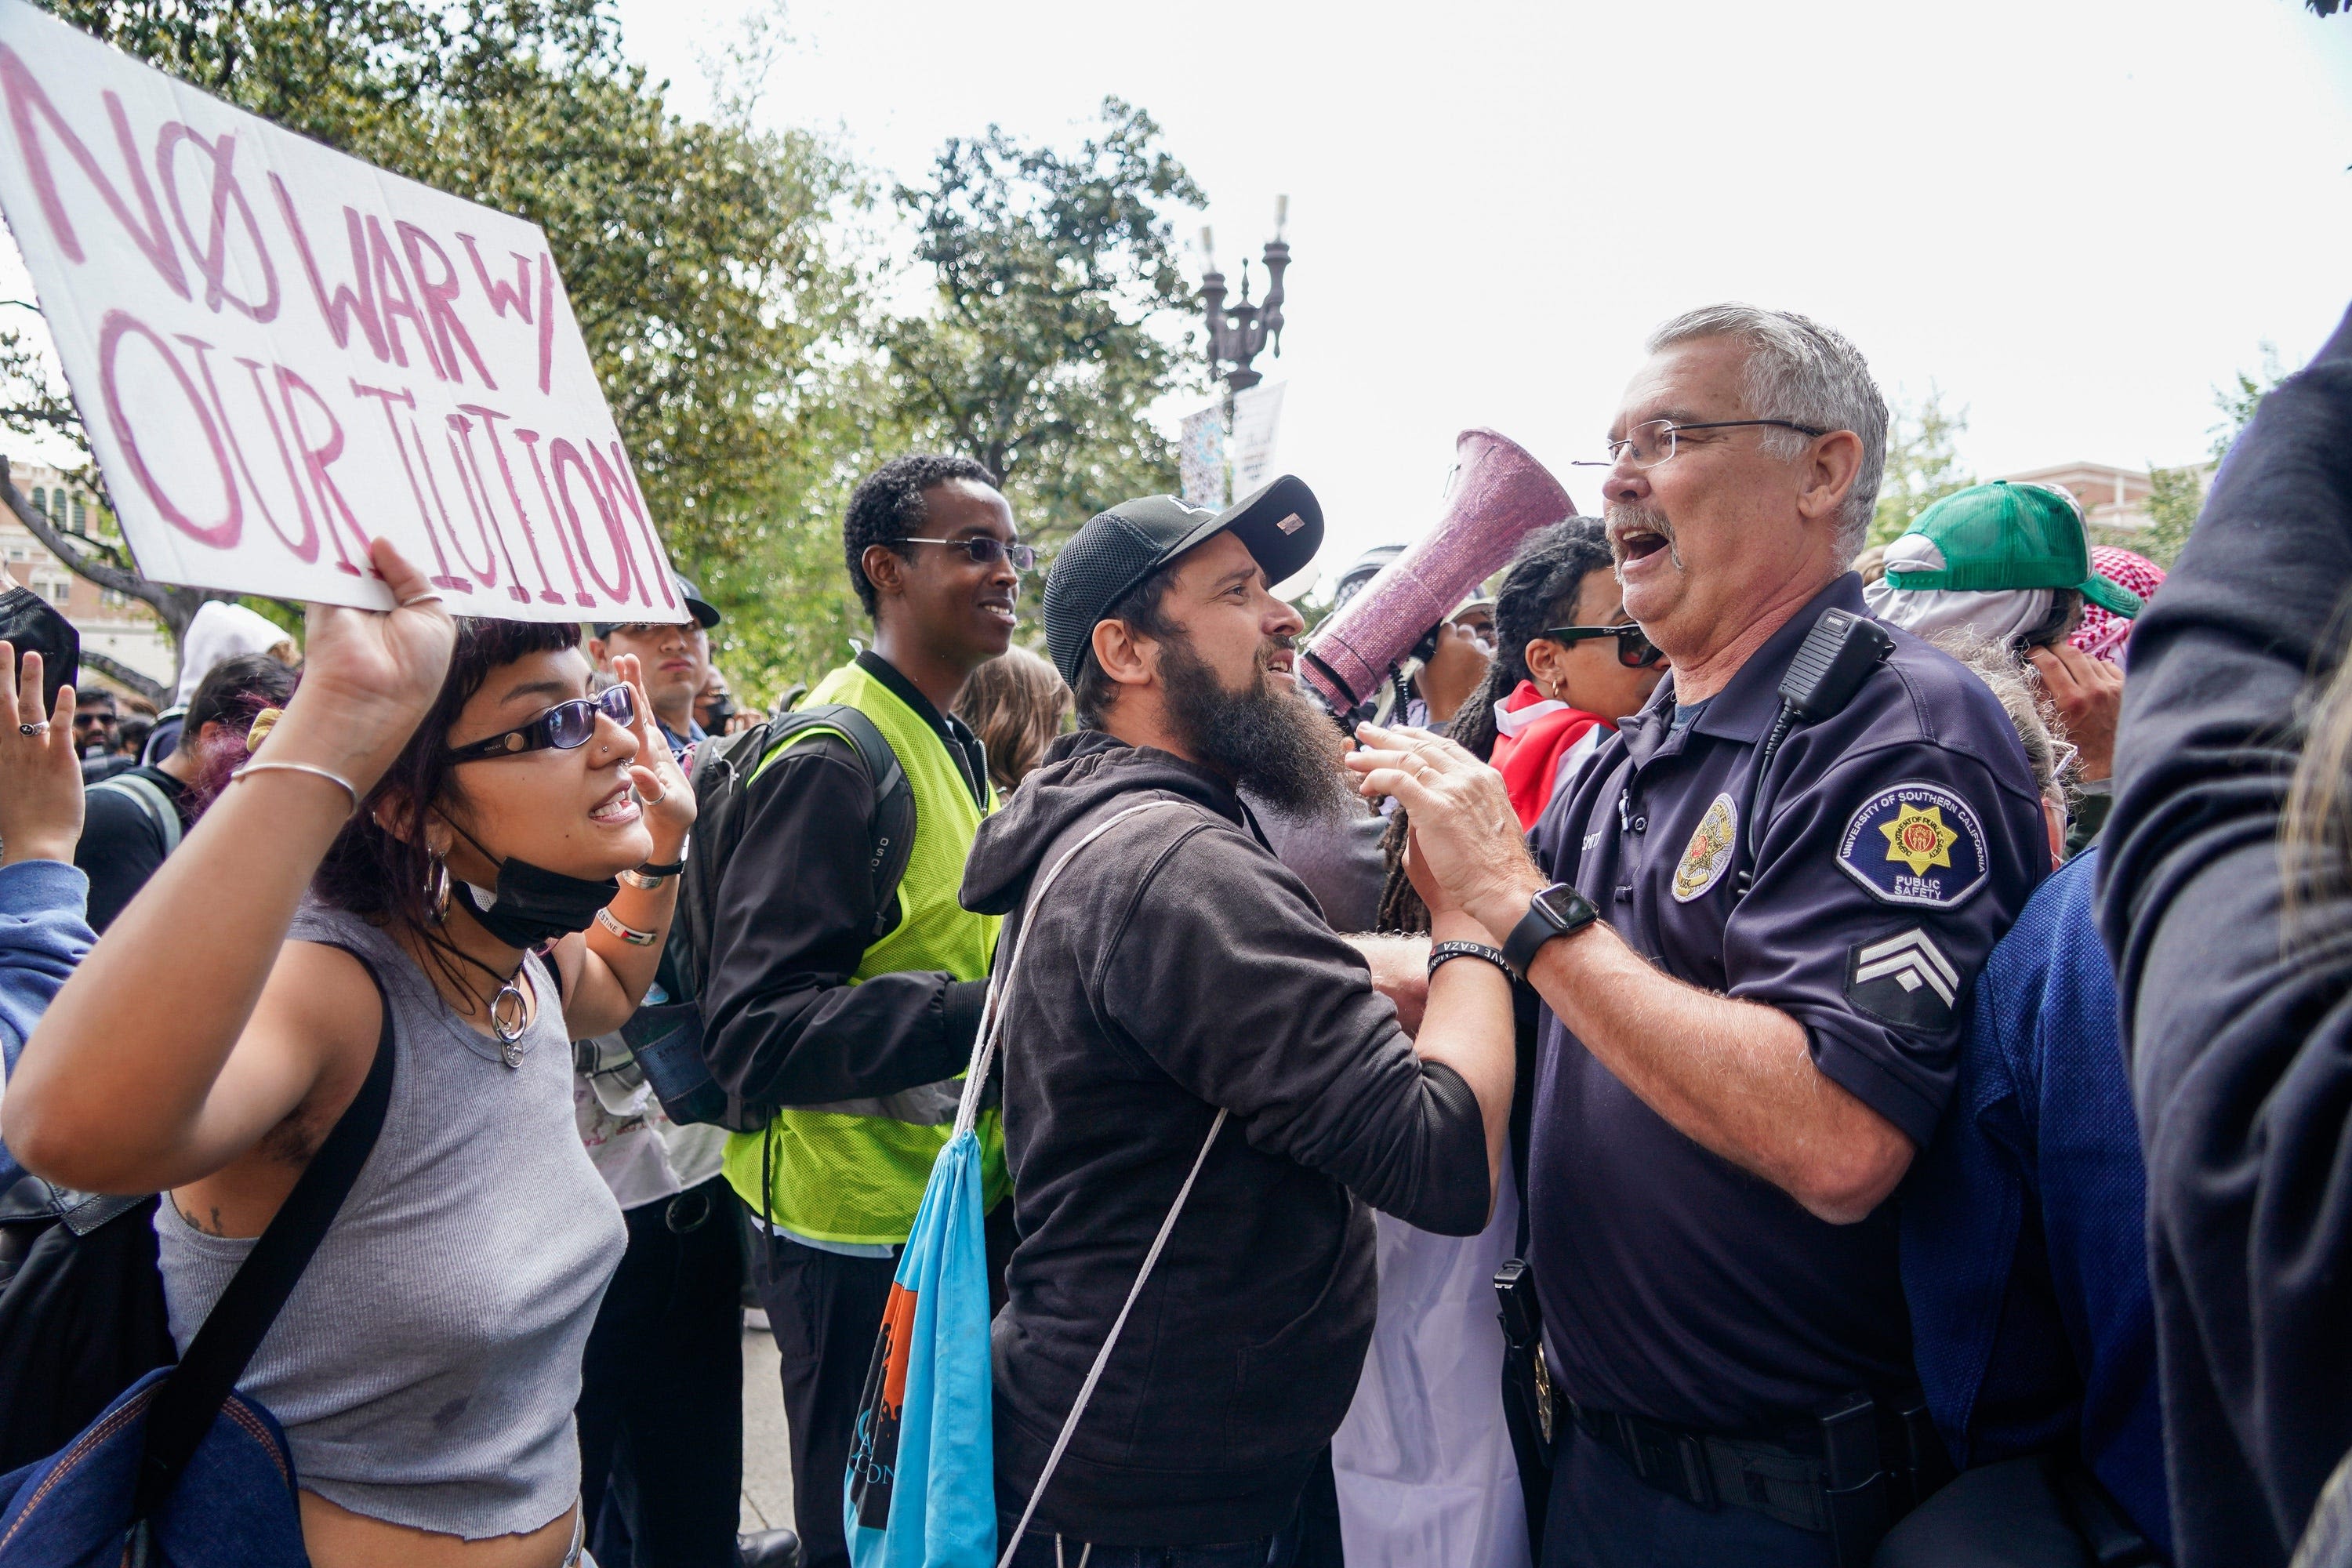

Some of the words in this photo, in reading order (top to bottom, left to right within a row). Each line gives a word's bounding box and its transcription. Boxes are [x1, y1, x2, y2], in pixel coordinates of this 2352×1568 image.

[267, 171, 499, 390] WAR
[455, 231, 555, 395] W/
[98, 309, 384, 580] OUR
[347, 376, 676, 611] TUITION
[1581, 829, 1602, 851] SMIT
[1842, 803, 1879, 858] UNIVERSITY
[1881, 794, 1895, 808] OF
[1898, 791, 1958, 814] SOUTHERN
[1958, 811, 1985, 873] CALIFORNIA
[1894, 885, 1941, 900] SAFETY
[1896, 876, 1940, 890] PUBLIC
[597, 910, 618, 933] ESTINE
[1443, 942, 1479, 953] GAZA
